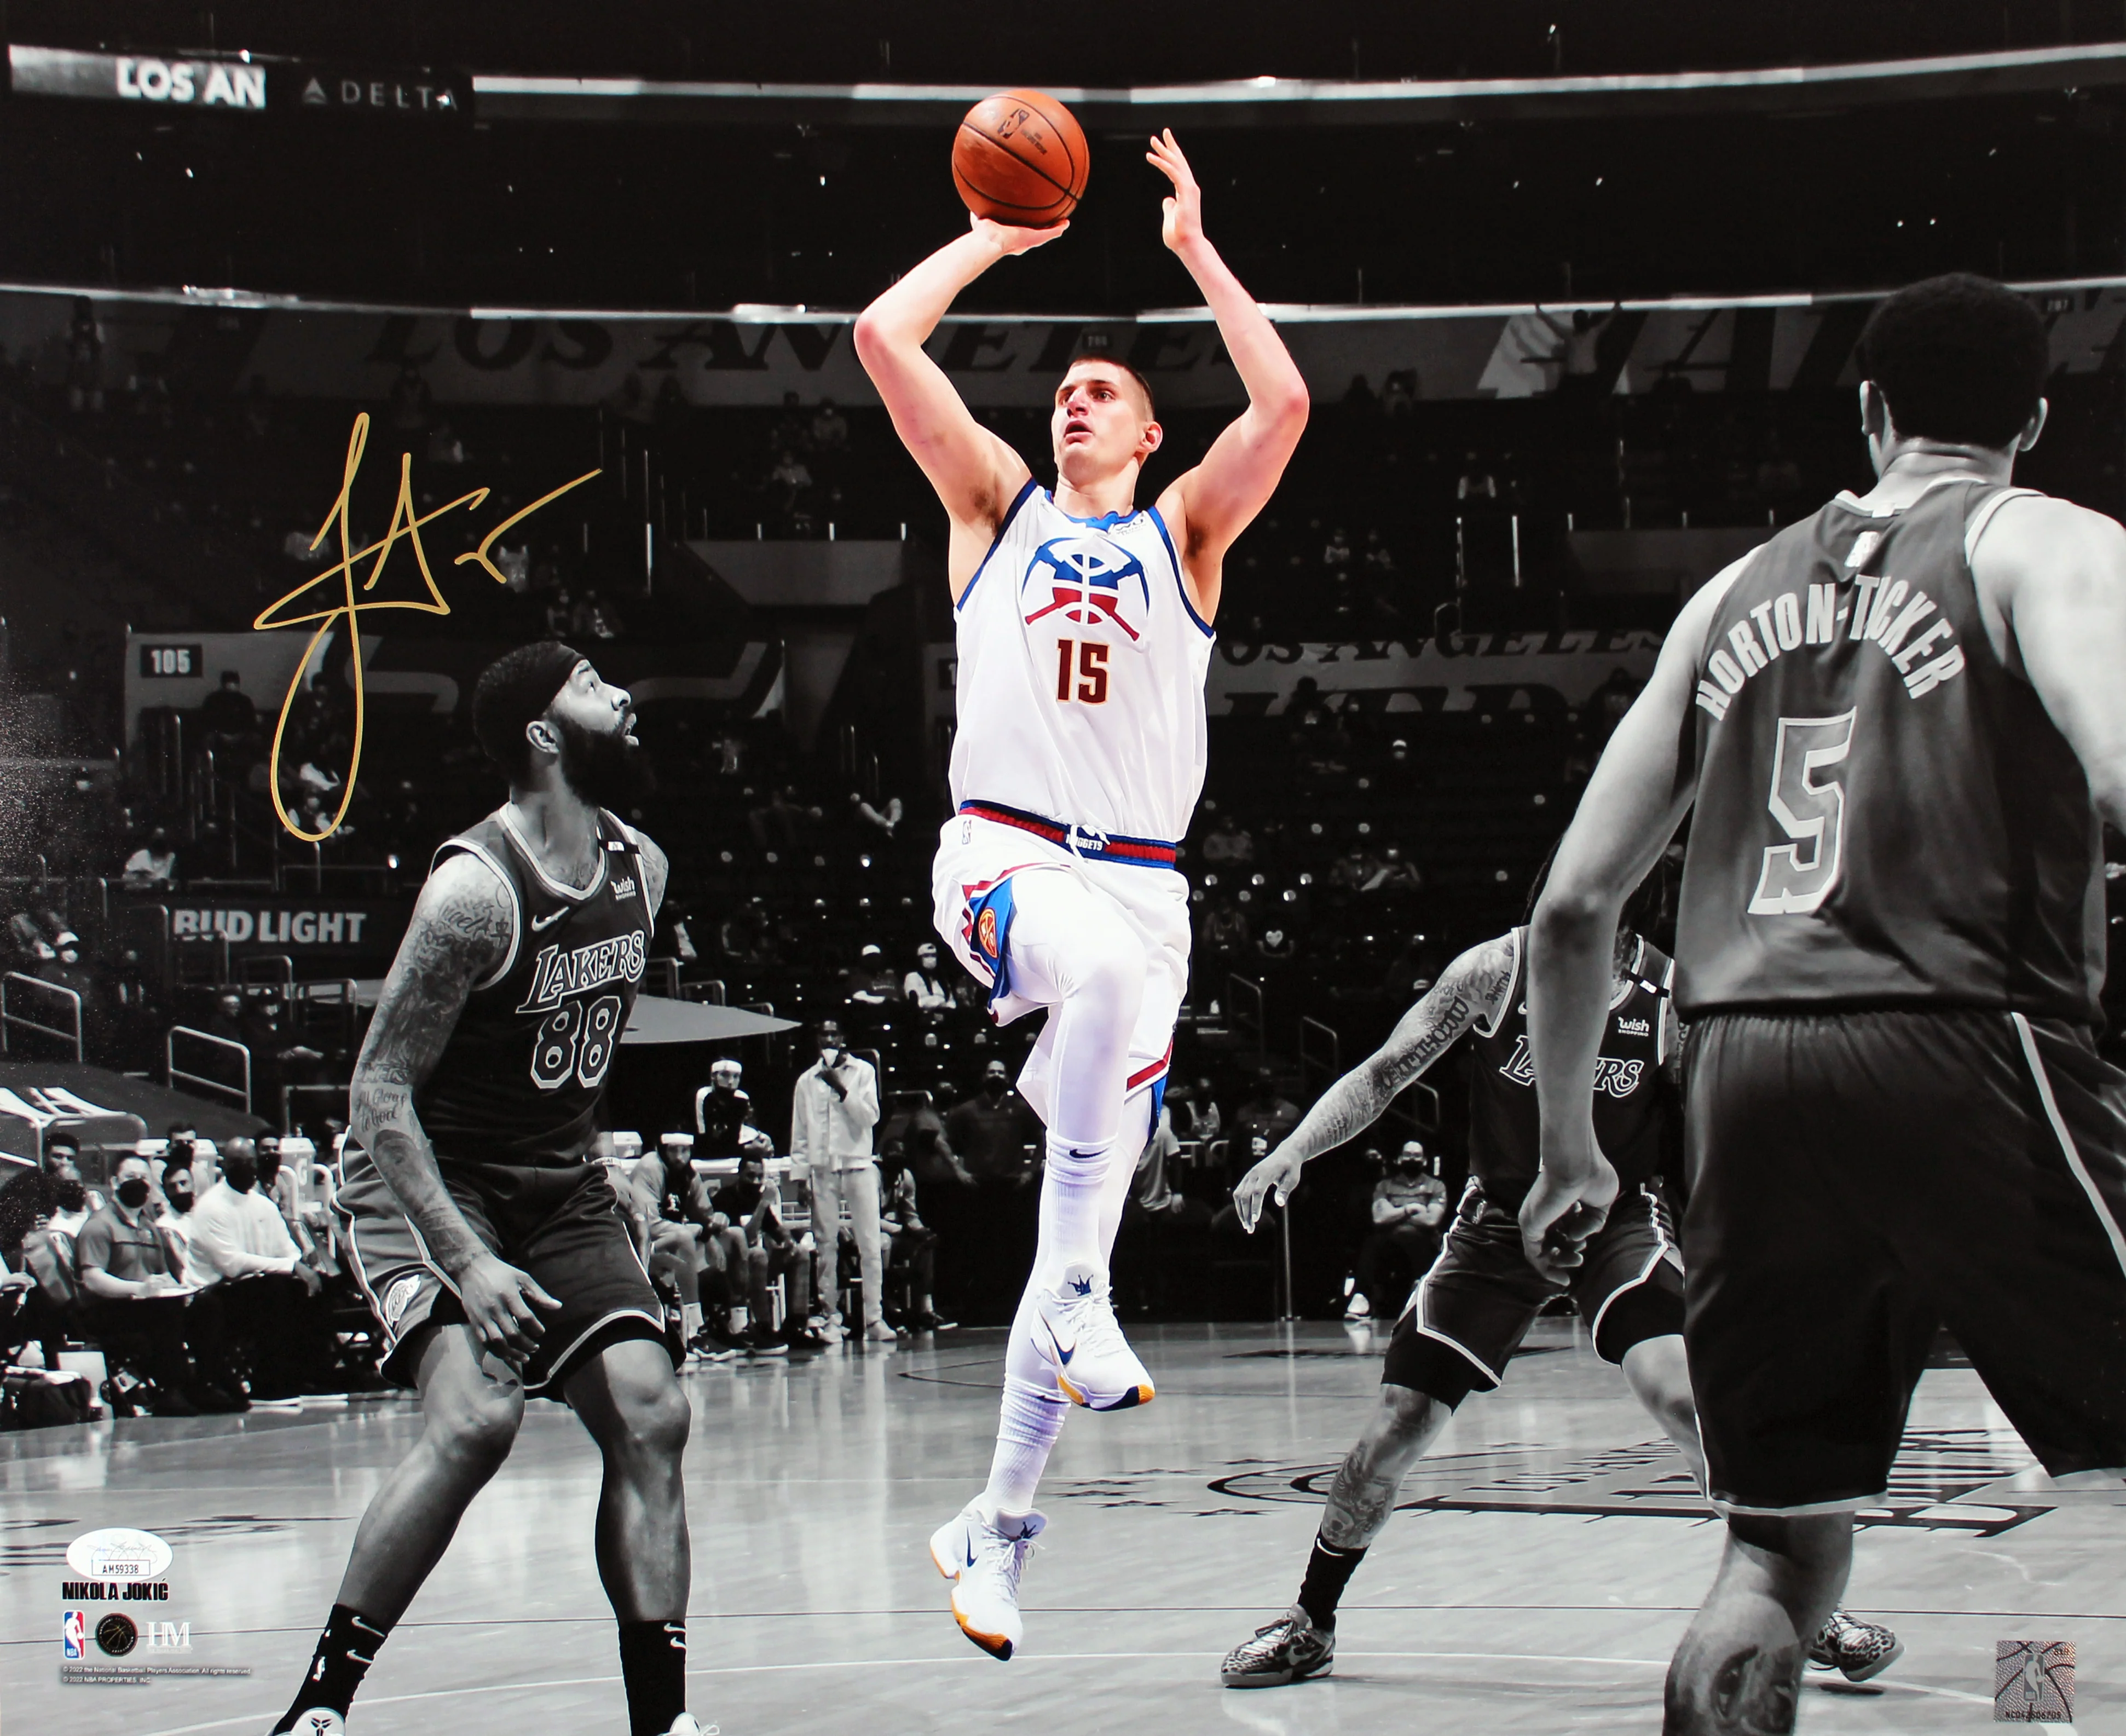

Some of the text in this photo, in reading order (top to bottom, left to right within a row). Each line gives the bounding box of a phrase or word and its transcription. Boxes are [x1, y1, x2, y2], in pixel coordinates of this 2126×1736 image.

[116, 59, 266, 109] LOS AN
[341, 79, 459, 112] DELTA
[150, 648, 192, 675] 105
[1056, 637, 1111, 706] 15
[1747, 706, 1857, 914] 5
[1065, 834, 1104, 851] GGETS
[610, 876, 635, 895] wish
[174, 909, 367, 943] BUD LIGHT
[516, 930, 646, 1014] LAKERS
[1618, 1016, 1650, 1032] wish
[530, 996, 622, 1089] 88
[102, 1564, 139, 1574] AM59338
